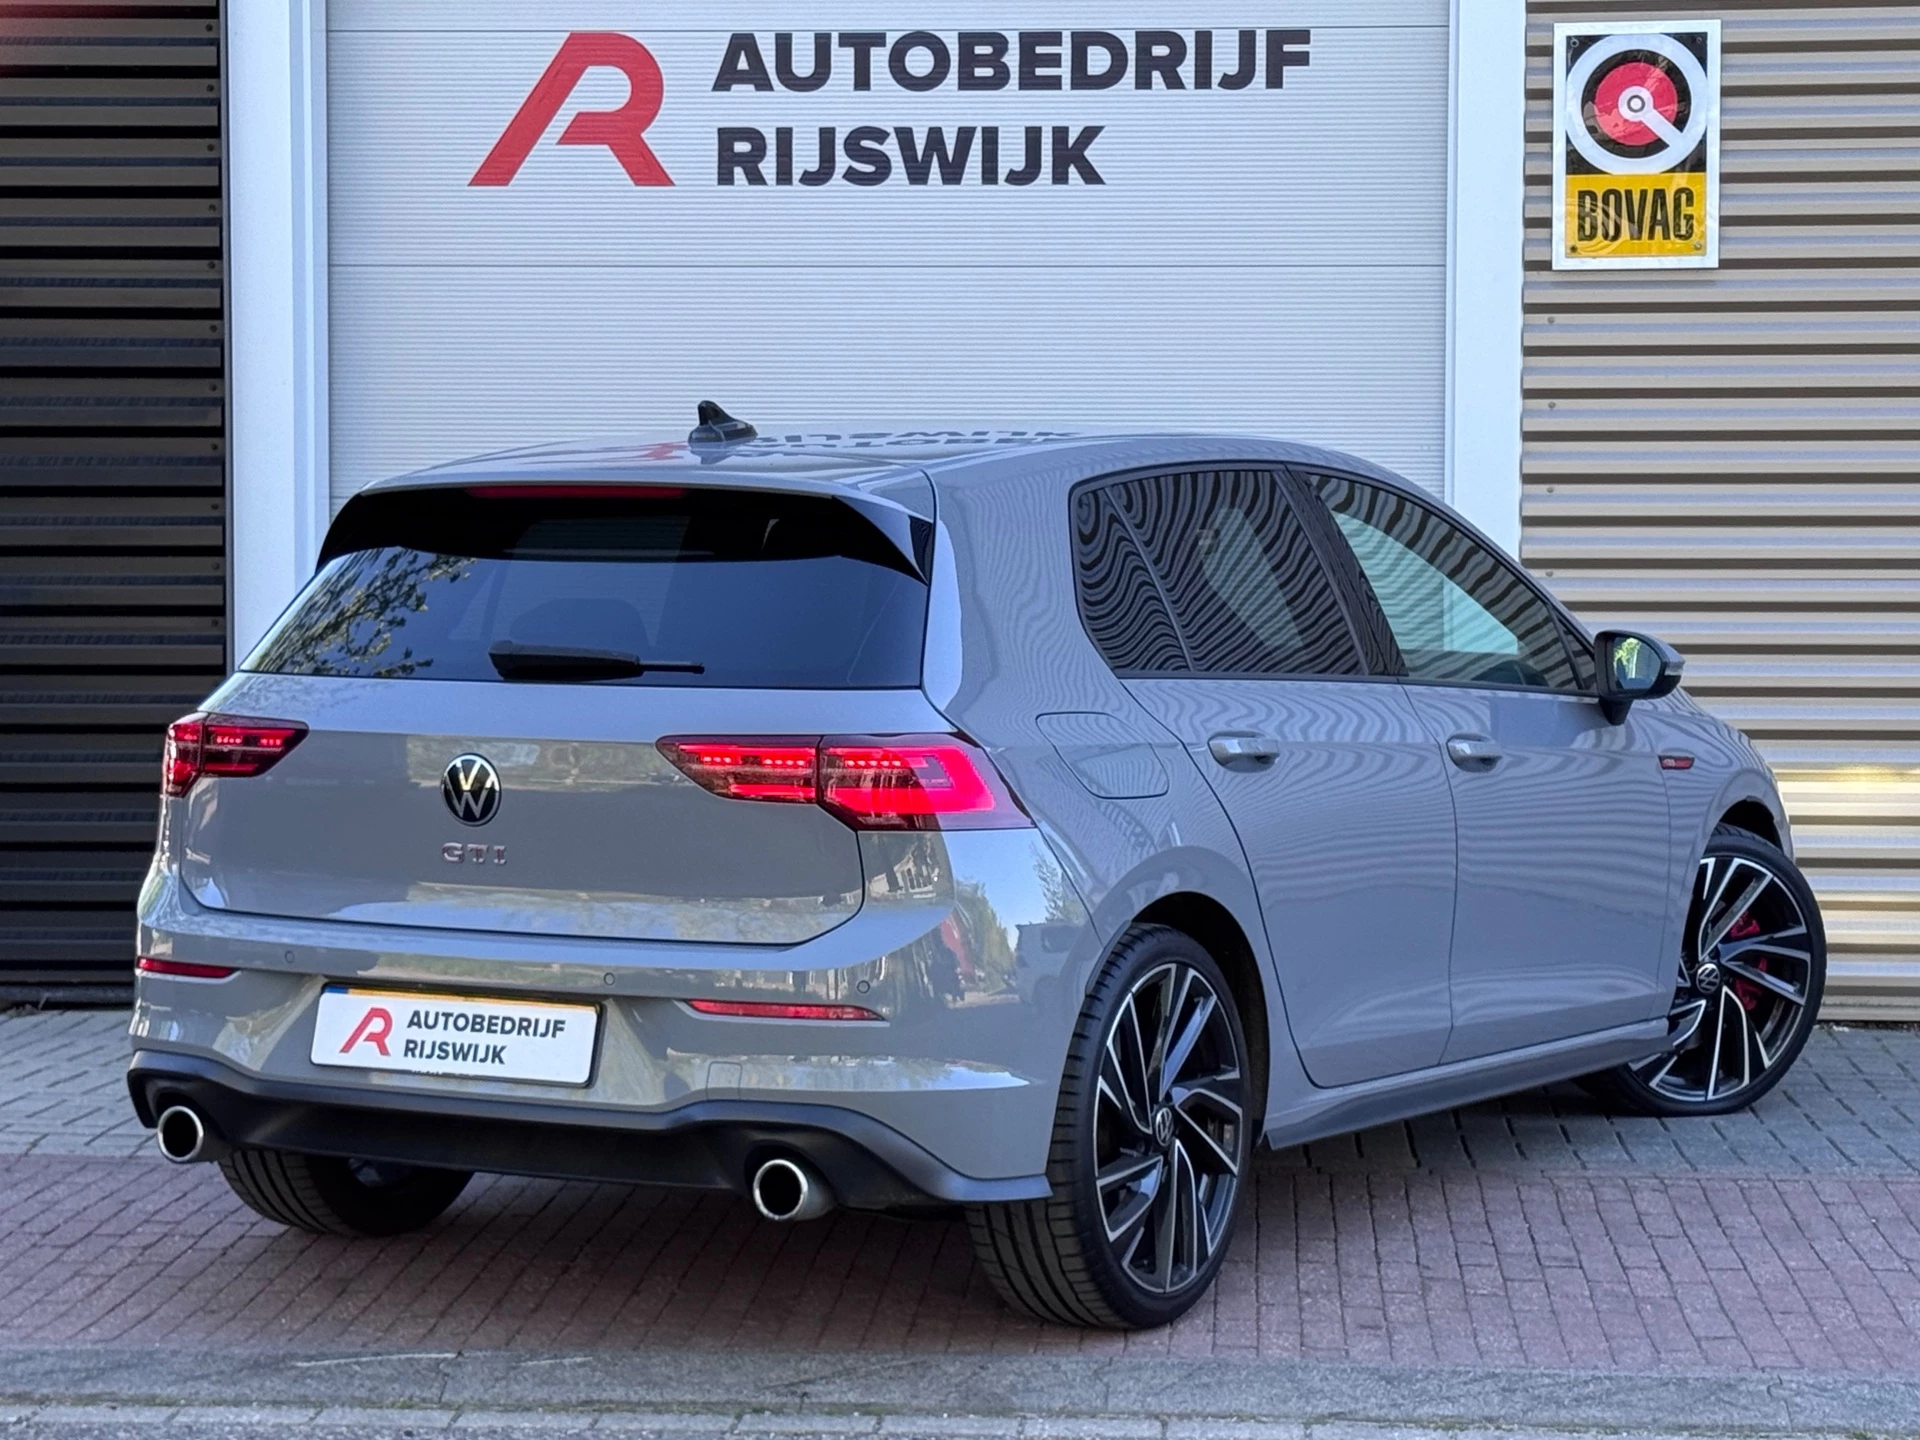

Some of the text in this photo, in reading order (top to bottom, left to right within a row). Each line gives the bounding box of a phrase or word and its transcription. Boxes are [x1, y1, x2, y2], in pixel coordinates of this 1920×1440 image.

[712, 29, 1311, 92] AUTOBEDRIJF
[717, 126, 1106, 186] RIJSWIJK
[1577, 187, 1695, 242] BOVAG
[441, 842, 507, 864] GTI
[406, 1010, 566, 1039] AUTOBEDRIJF
[403, 1039, 508, 1065] RIJSWIJK
